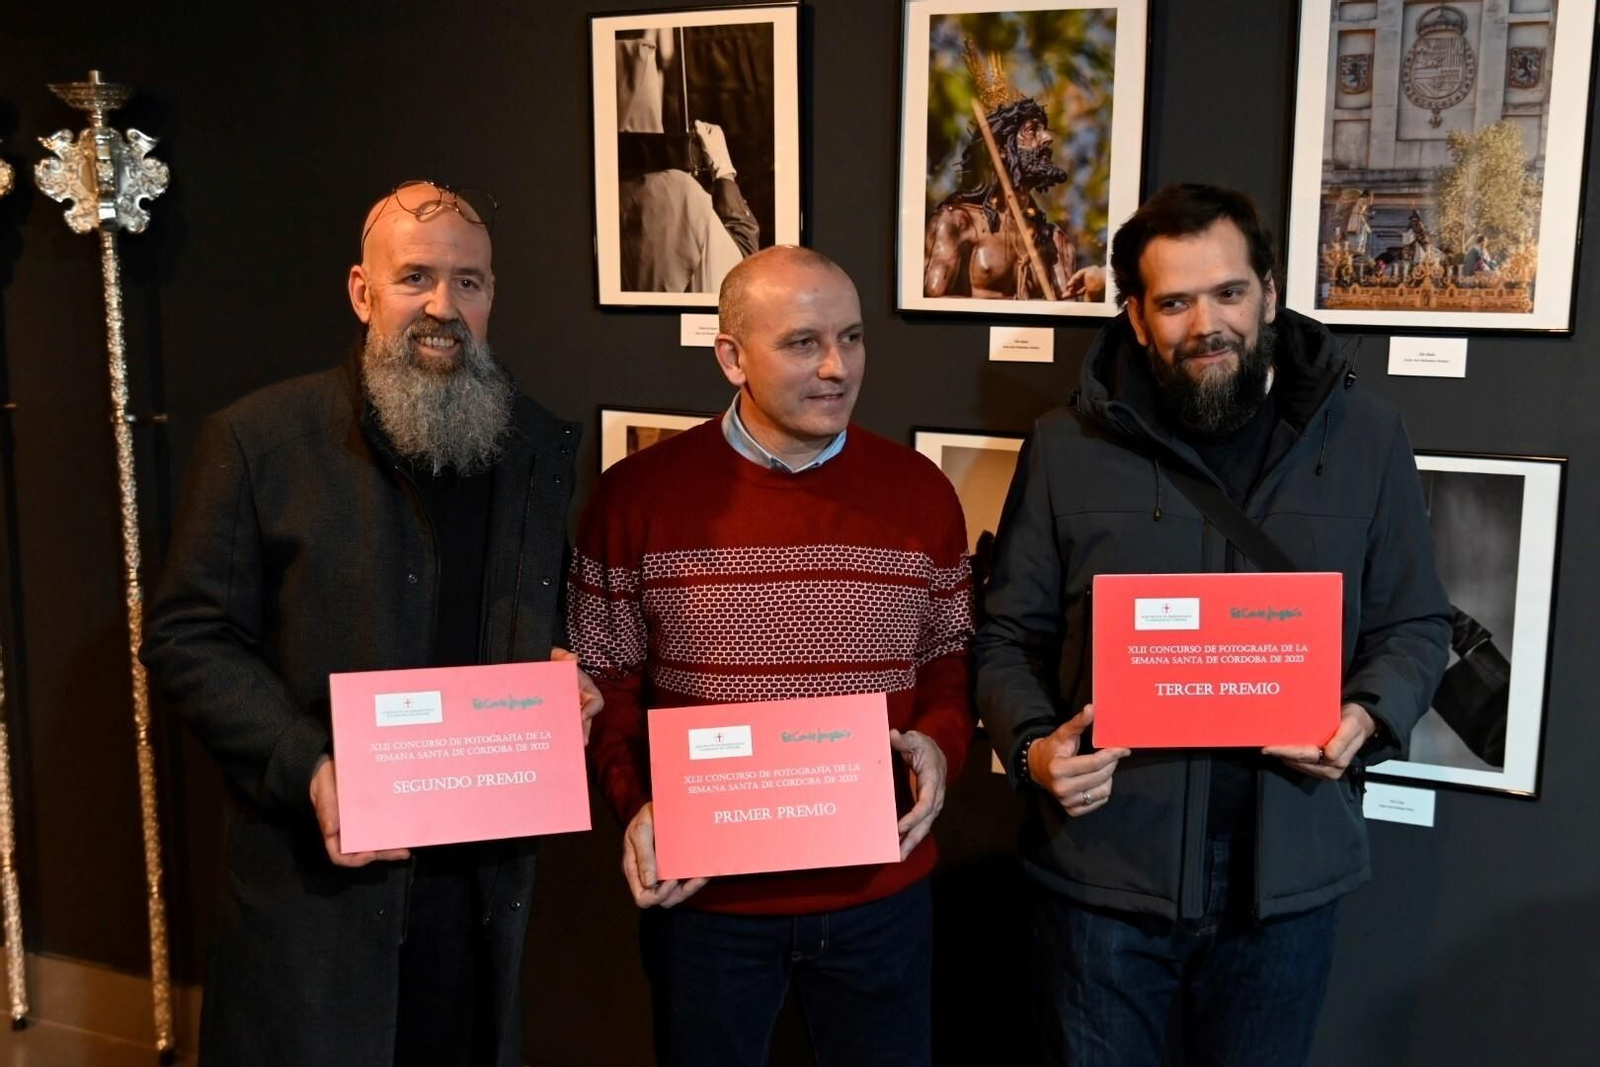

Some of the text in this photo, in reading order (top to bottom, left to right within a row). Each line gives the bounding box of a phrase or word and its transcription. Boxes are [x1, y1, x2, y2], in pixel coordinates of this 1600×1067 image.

[1128, 645, 1147, 654] XLII
[1149, 644, 1202, 654] CONCURSO
[1204, 644, 1217, 653] DE
[1281, 643, 1294, 652] DE
[1295, 643, 1308, 652] LA
[1131, 656, 1170, 665] SEMANA
[1172, 656, 1203, 664] SANTA
[1206, 655, 1219, 664] DE
[1269, 655, 1282, 663] DE
[1284, 654, 1305, 663] 2023
[1155, 682, 1281, 696] TERCER PREMIO
[371, 742, 391, 751] XLII
[393, 739, 447, 750] CONCURSO
[449, 737, 463, 746] DE
[526, 731, 539, 741] DE
[540, 730, 553, 740] LA
[375, 752, 415, 762] SEMANA
[417, 749, 450, 760] SANTA
[452, 748, 465, 757] DE
[516, 743, 529, 752] DE
[530, 742, 550, 751] 2023
[394, 770, 538, 794] SEGUNDO PREMIO
[685, 774, 703, 784] XLII
[705, 771, 757, 782] CONCURSO
[759, 769, 771, 778] DE
[834, 763, 846, 773] DE
[848, 762, 861, 772] LA
[688, 784, 726, 794] SEMANA
[728, 781, 760, 791] SANTA
[762, 780, 774, 789] DE
[824, 775, 836, 784] DE
[714, 802, 837, 824] PRIMER PREMIO
